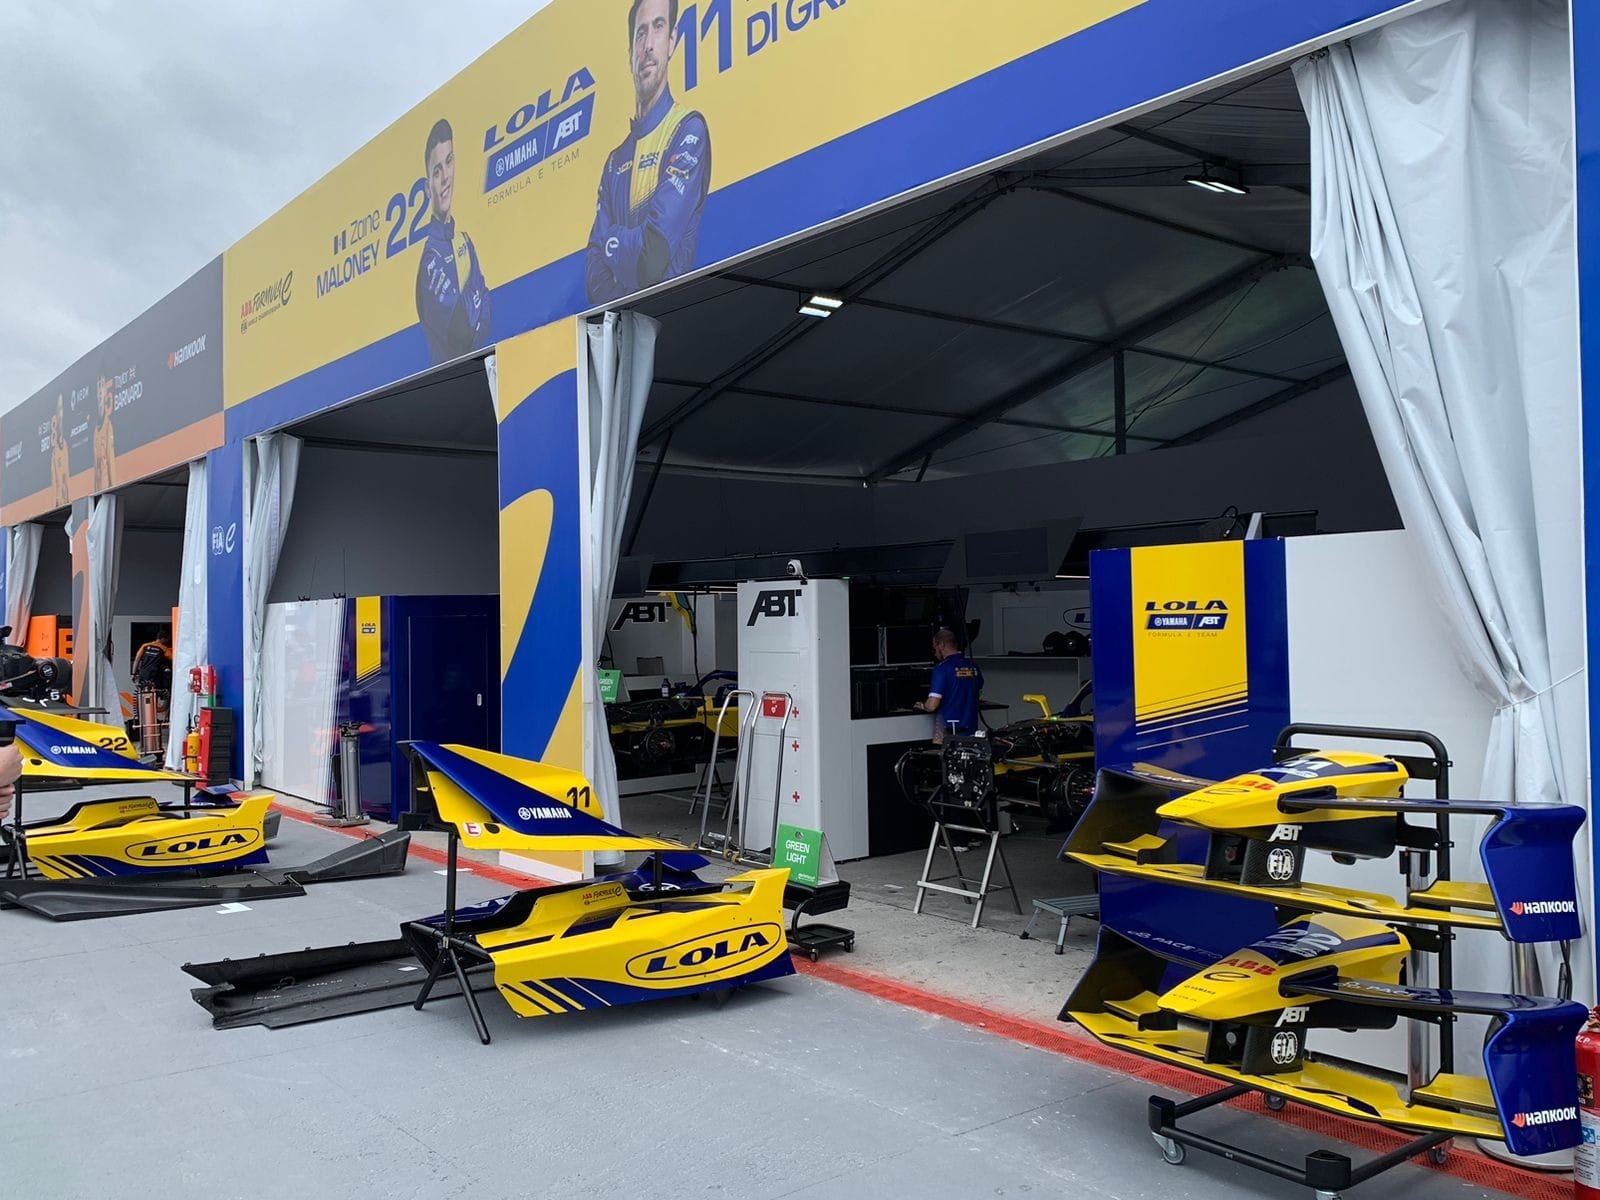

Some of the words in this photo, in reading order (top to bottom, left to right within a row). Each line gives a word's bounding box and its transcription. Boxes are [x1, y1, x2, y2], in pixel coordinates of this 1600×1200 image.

[747, 2, 778, 56] DI
[667, 0, 732, 91] 11
[483, 67, 596, 152] LOLA
[504, 138, 538, 172] YAMAHA
[553, 110, 582, 150] ABT
[680, 134, 700, 147] ABT
[487, 176, 532, 208] FORMULA
[538, 168, 544, 180] E
[551, 149, 581, 172] TEAM
[316, 238, 381, 299] MALONEY
[385, 177, 431, 259] 22
[349, 209, 381, 246] Zane
[114, 381, 143, 411] BARNARD
[610, 600, 672, 632] ABT
[747, 589, 802, 627] ABT
[1145, 600, 1228, 611] LOLA
[1162, 617, 1188, 626] YAMAHA
[1198, 616, 1222, 628] ABT
[61, 745, 97, 755] YAMAHA
[99, 737, 128, 752] 22
[566, 786, 590, 809] 11
[531, 807, 572, 819] YAMAHA
[466, 822, 478, 835] E
[1267, 824, 1303, 842] ABT
[141, 833, 249, 857] LOLA
[785, 839, 810, 854] GREEN
[786, 851, 807, 865] LIGHT
[1268, 852, 1293, 876] FIA
[1265, 928, 1342, 952] 22
[645, 932, 770, 974] LOLA
[1217, 958, 1276, 977] ABB
[1274, 1006, 1311, 1028] ABT
[1272, 1036, 1296, 1060] FIA
